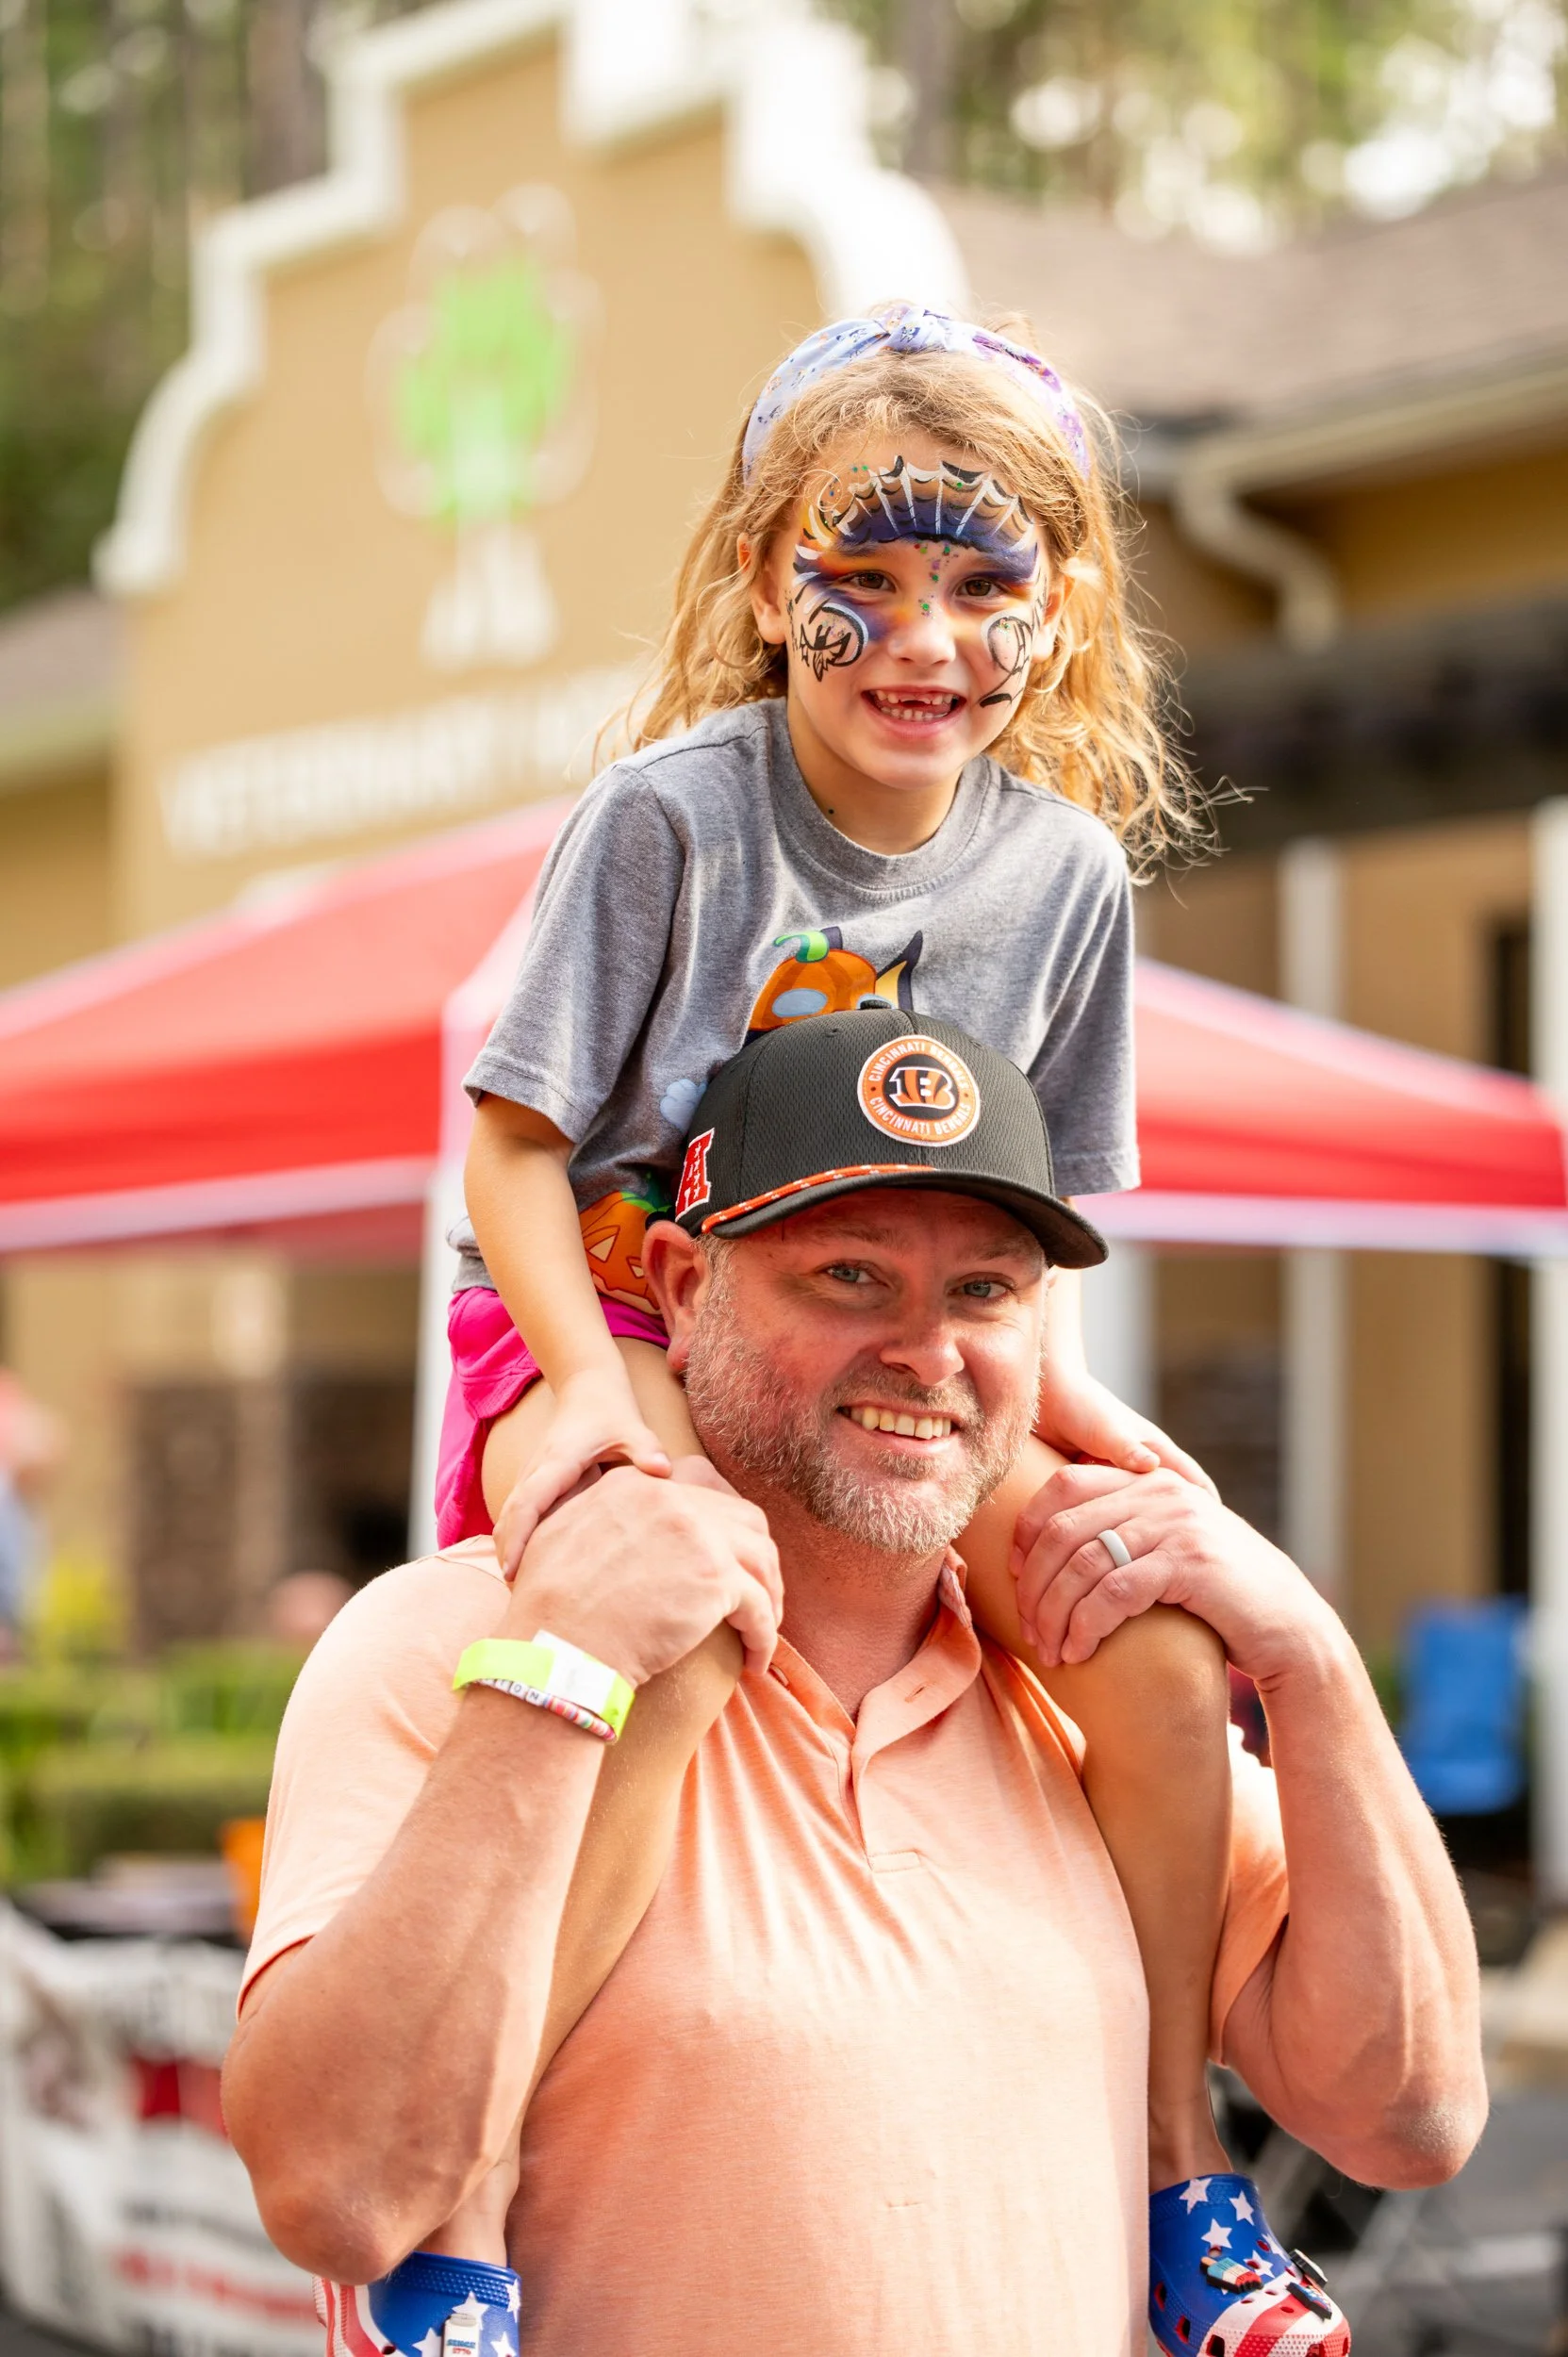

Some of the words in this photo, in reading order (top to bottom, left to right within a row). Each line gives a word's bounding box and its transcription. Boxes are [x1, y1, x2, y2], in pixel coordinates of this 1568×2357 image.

[868, 1041, 925, 1081] CINCINNATI
[929, 1045, 969, 1089] BENGALS
[869, 1096, 931, 1134] CINCINNATI
[933, 1104, 972, 1135] BENGALS
